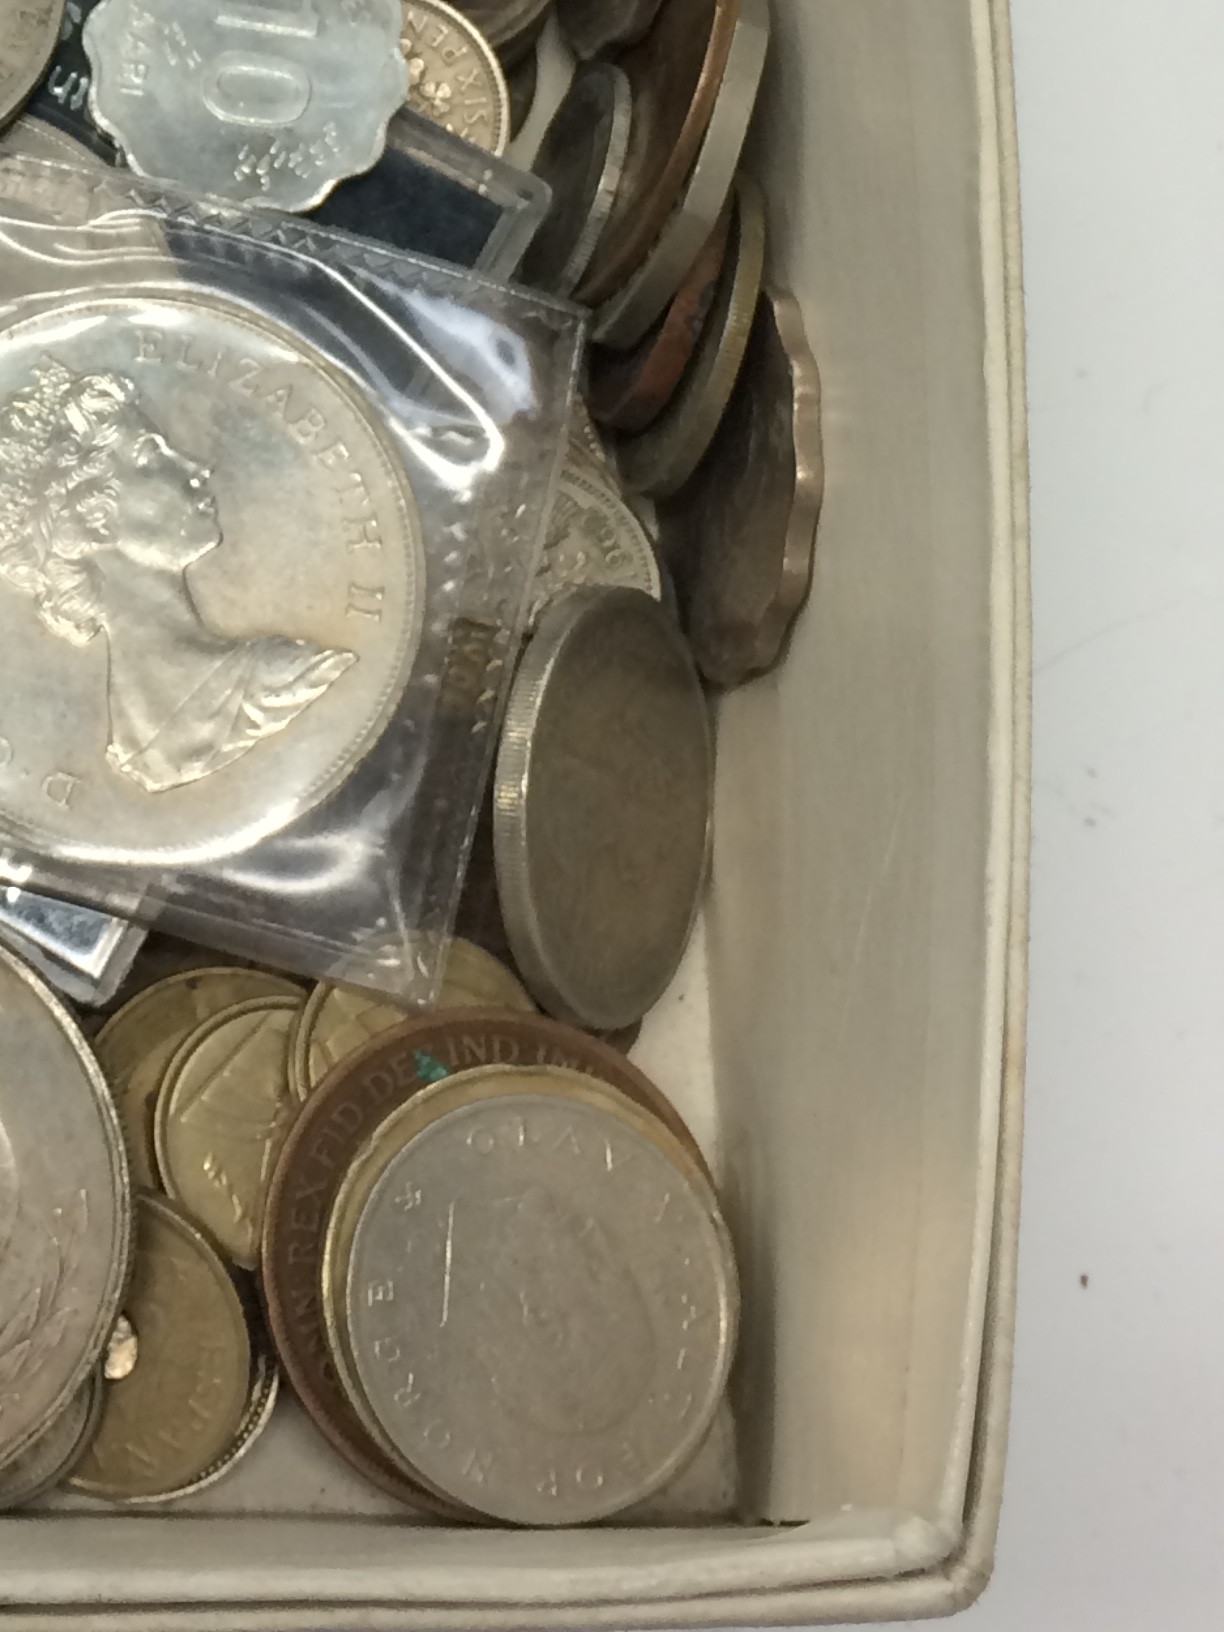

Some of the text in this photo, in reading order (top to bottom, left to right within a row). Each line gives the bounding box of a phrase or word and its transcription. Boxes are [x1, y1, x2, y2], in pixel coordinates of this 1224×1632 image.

[132, 327, 384, 552] ELIZABETH
[345, 582, 386, 625] II
[287, 1174, 333, 1267] REX
[317, 1095, 366, 1170] FID
[444, 1032, 521, 1069] IND
